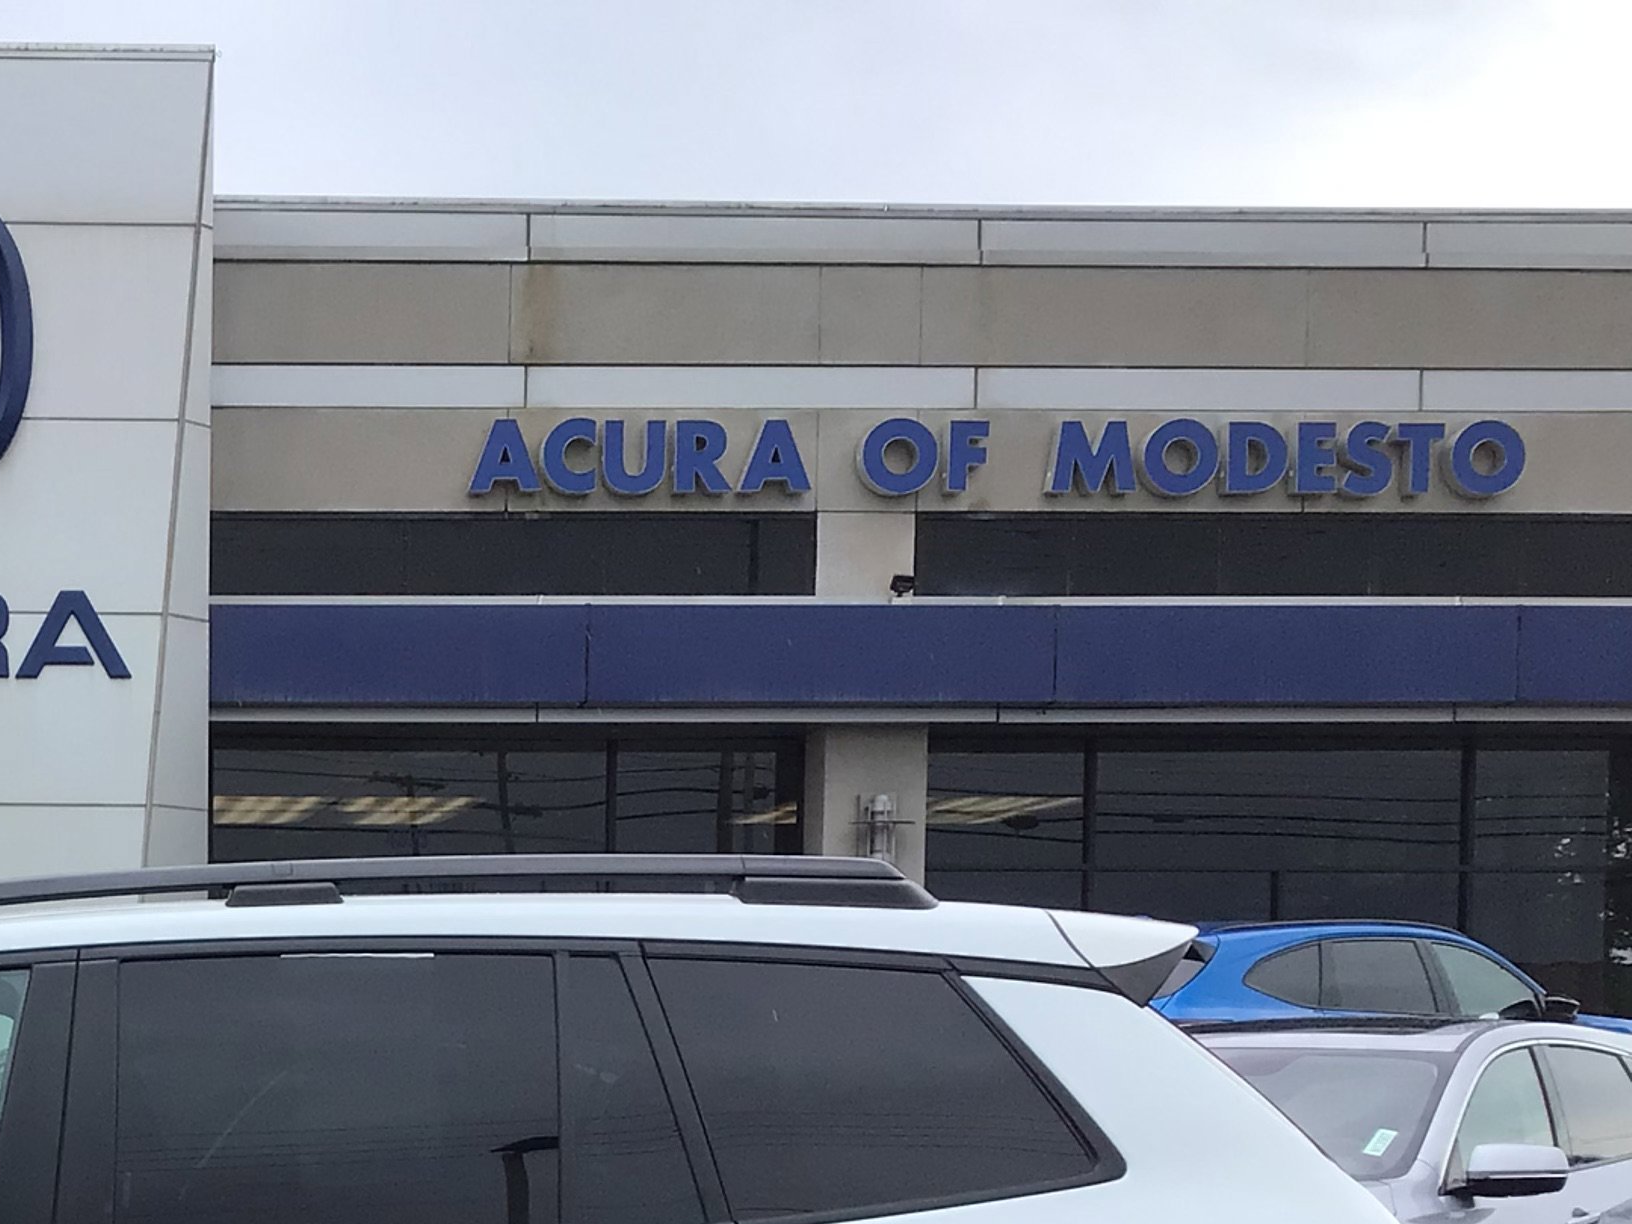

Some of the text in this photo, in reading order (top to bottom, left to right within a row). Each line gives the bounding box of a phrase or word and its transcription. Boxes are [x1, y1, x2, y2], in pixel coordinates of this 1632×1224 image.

[467, 416, 1527, 497] ACURA OF MODESTO
